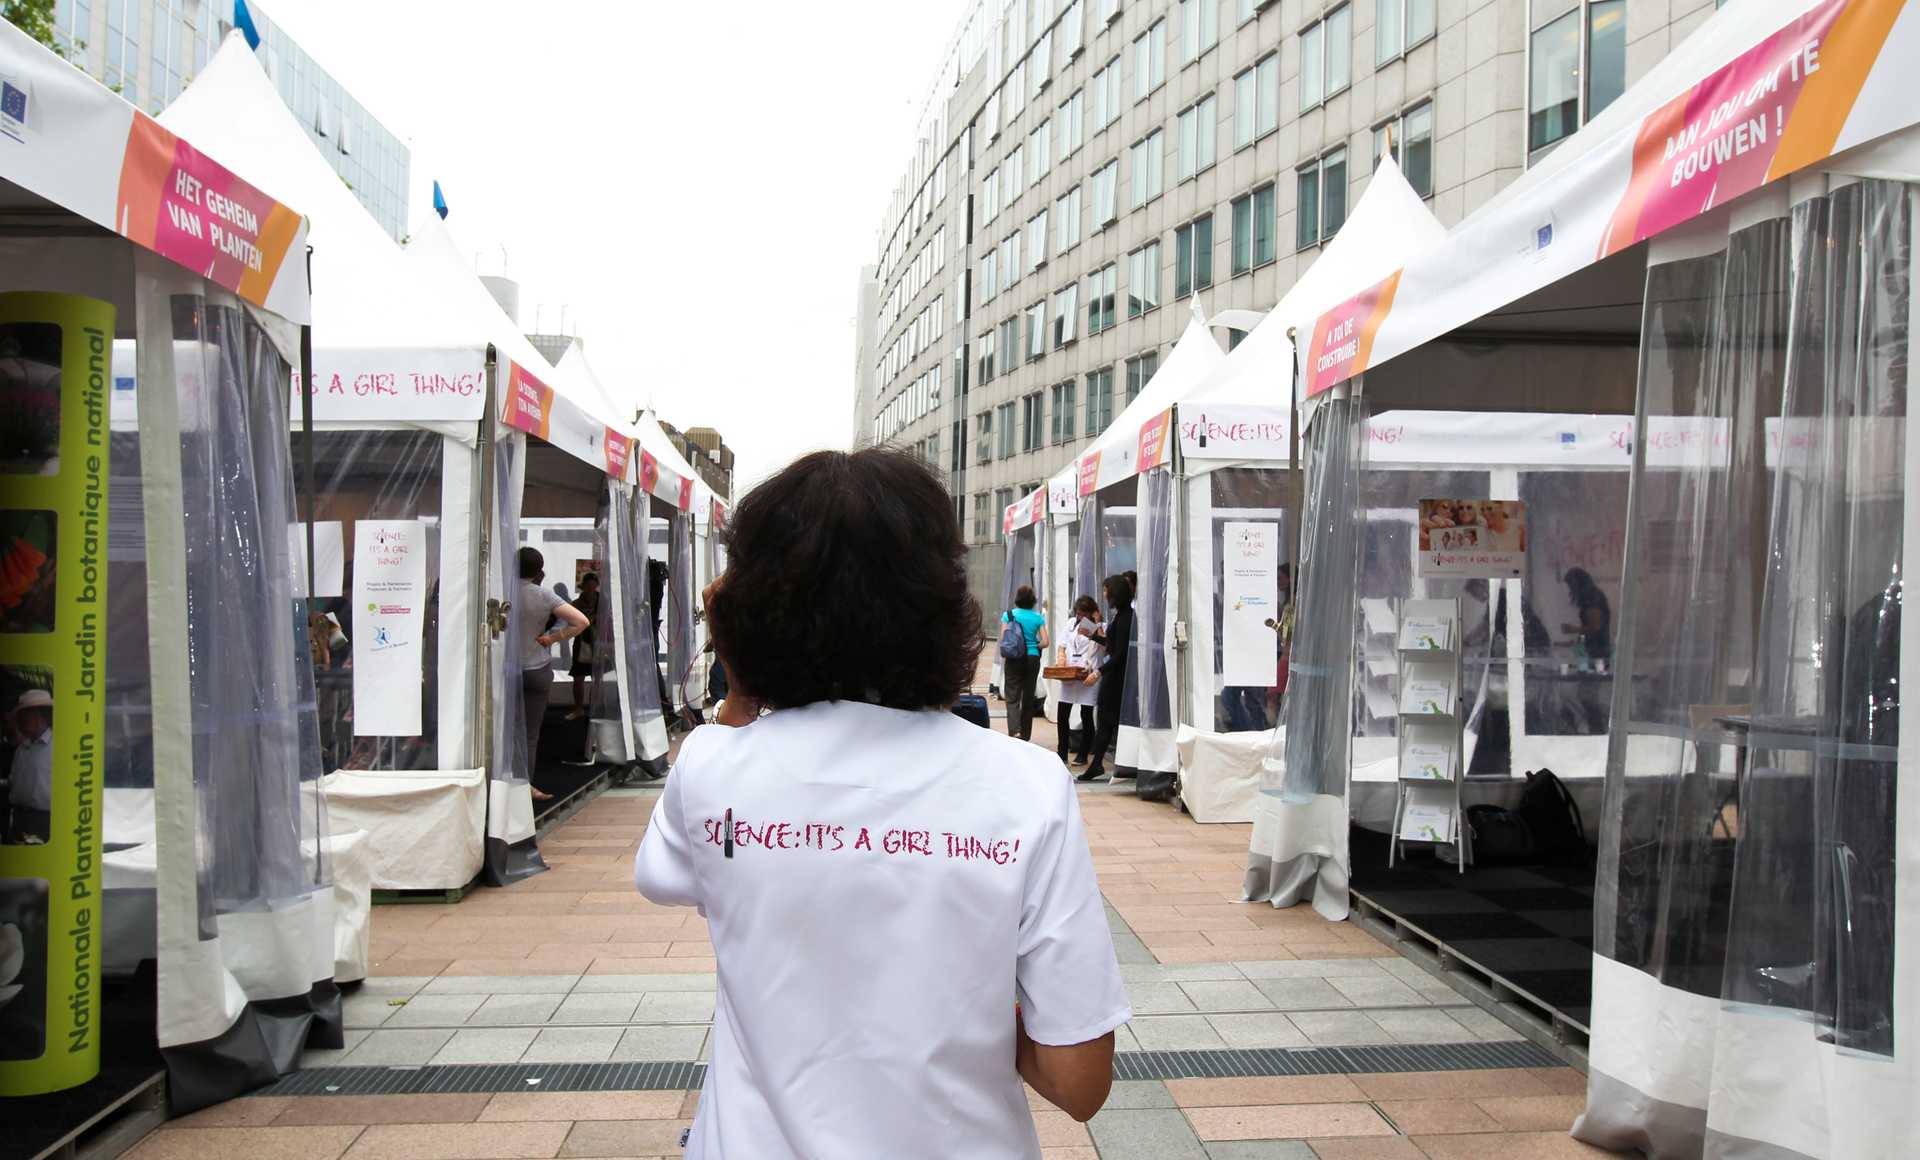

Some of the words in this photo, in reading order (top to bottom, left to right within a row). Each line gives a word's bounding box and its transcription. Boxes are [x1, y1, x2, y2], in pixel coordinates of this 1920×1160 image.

[1701, 90, 1745, 138] JOU
[1743, 63, 1782, 108] OM
[1791, 39, 1821, 83] TE
[1670, 113, 1767, 189] BOUWEN
[1775, 105, 1783, 137] !
[166, 200, 203, 240] VAN
[209, 222, 263, 274] PLANTEN
[175, 168, 203, 207] HET
[205, 188, 258, 236] GEHEIM
[1344, 317, 1354, 337] DE
[81, 326, 106, 447] national
[328, 373, 345, 395] A
[353, 373, 399, 397] GIRL
[408, 371, 483, 397] THING!
[76, 454, 104, 603] botanique
[75, 611, 98, 704] Jardin
[71, 733, 96, 899] Plantentuin
[854, 827, 872, 852] A
[883, 829, 933, 856] GIRL
[941, 832, 1021, 865] THING!
[67, 907, 91, 1055] Nationale
